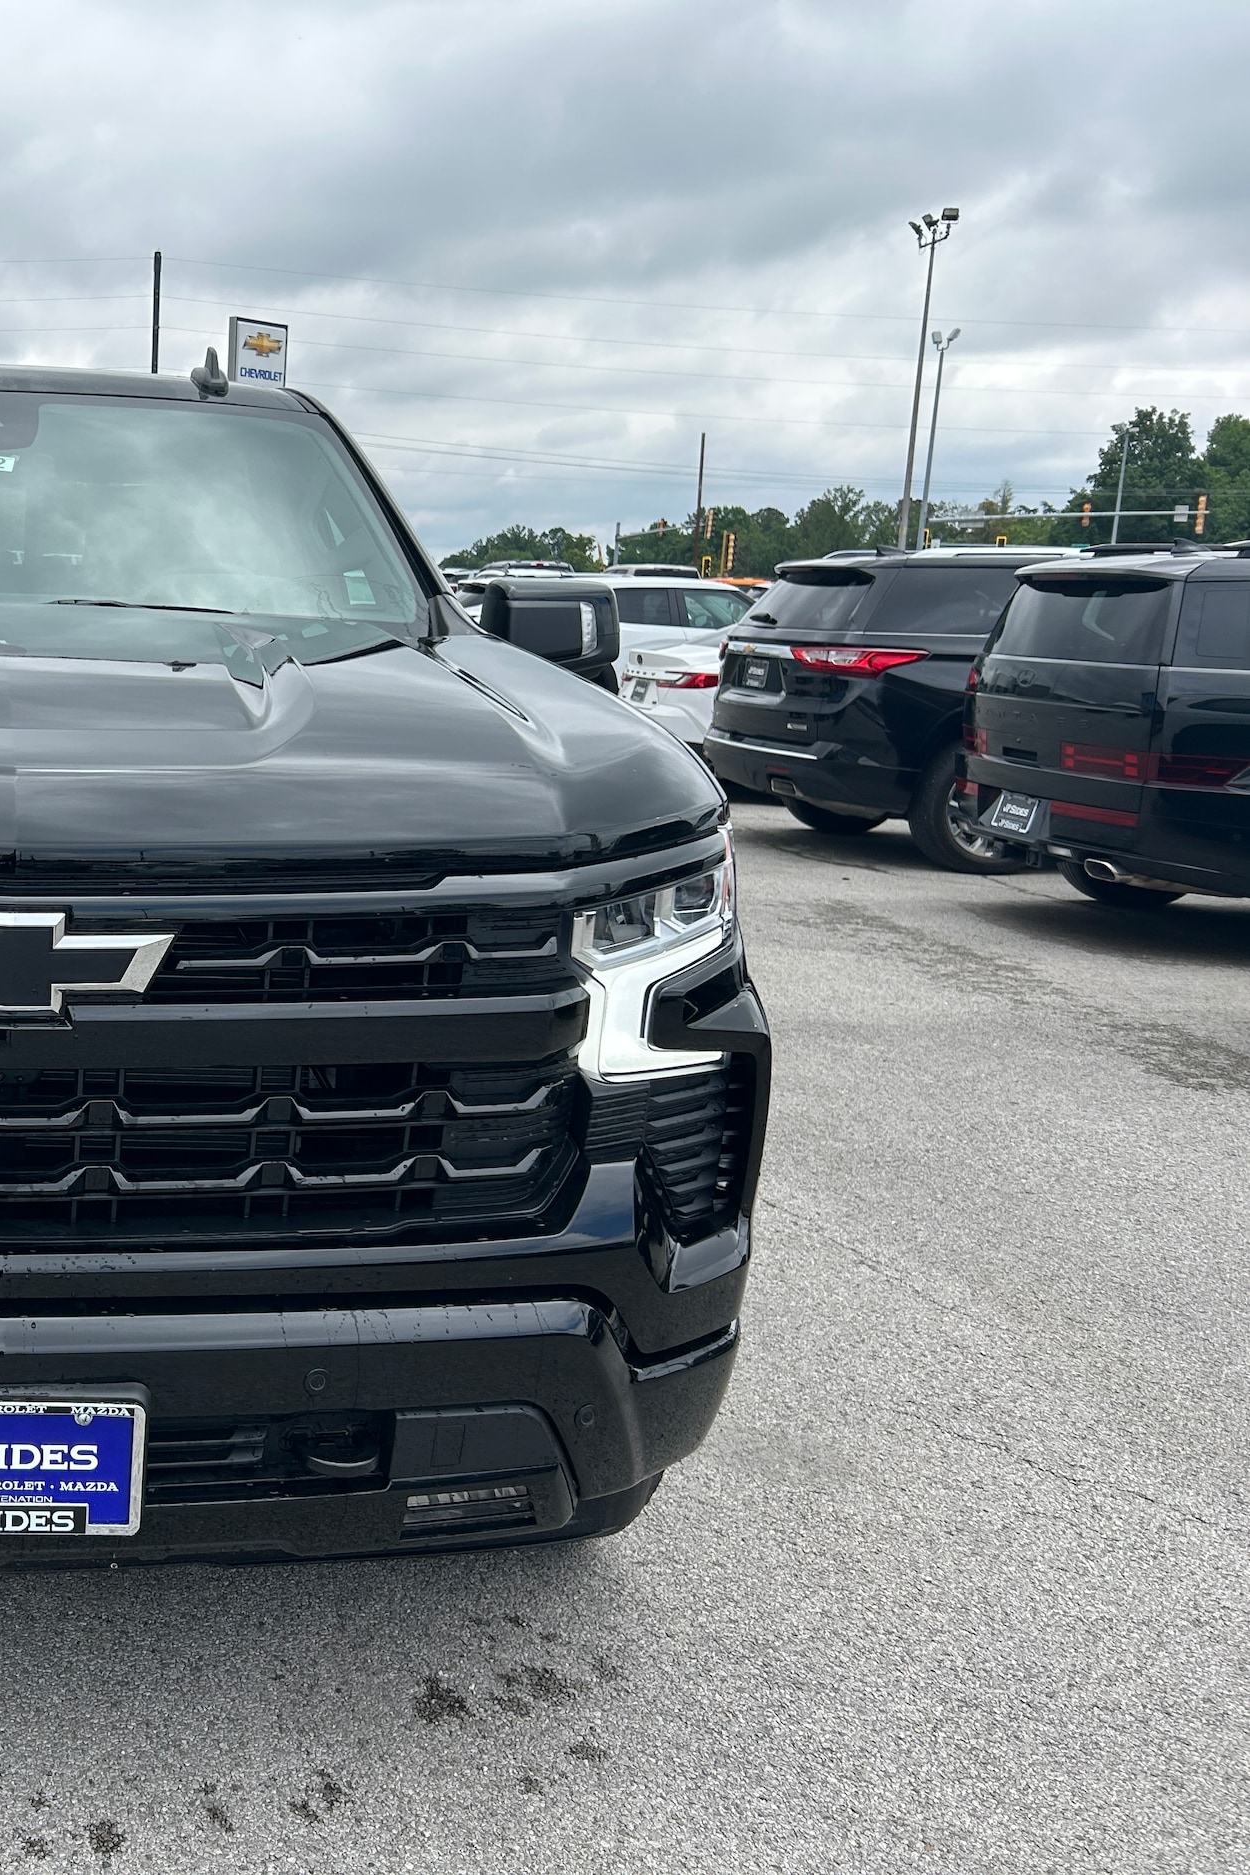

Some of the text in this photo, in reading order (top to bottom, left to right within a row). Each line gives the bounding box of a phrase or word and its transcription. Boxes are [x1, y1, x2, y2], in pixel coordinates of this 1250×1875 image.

[240, 367, 283, 382] CHEVROLET
[70, 1405, 131, 1416] MAZDA
[59, 1481, 119, 1492] MAZDA
